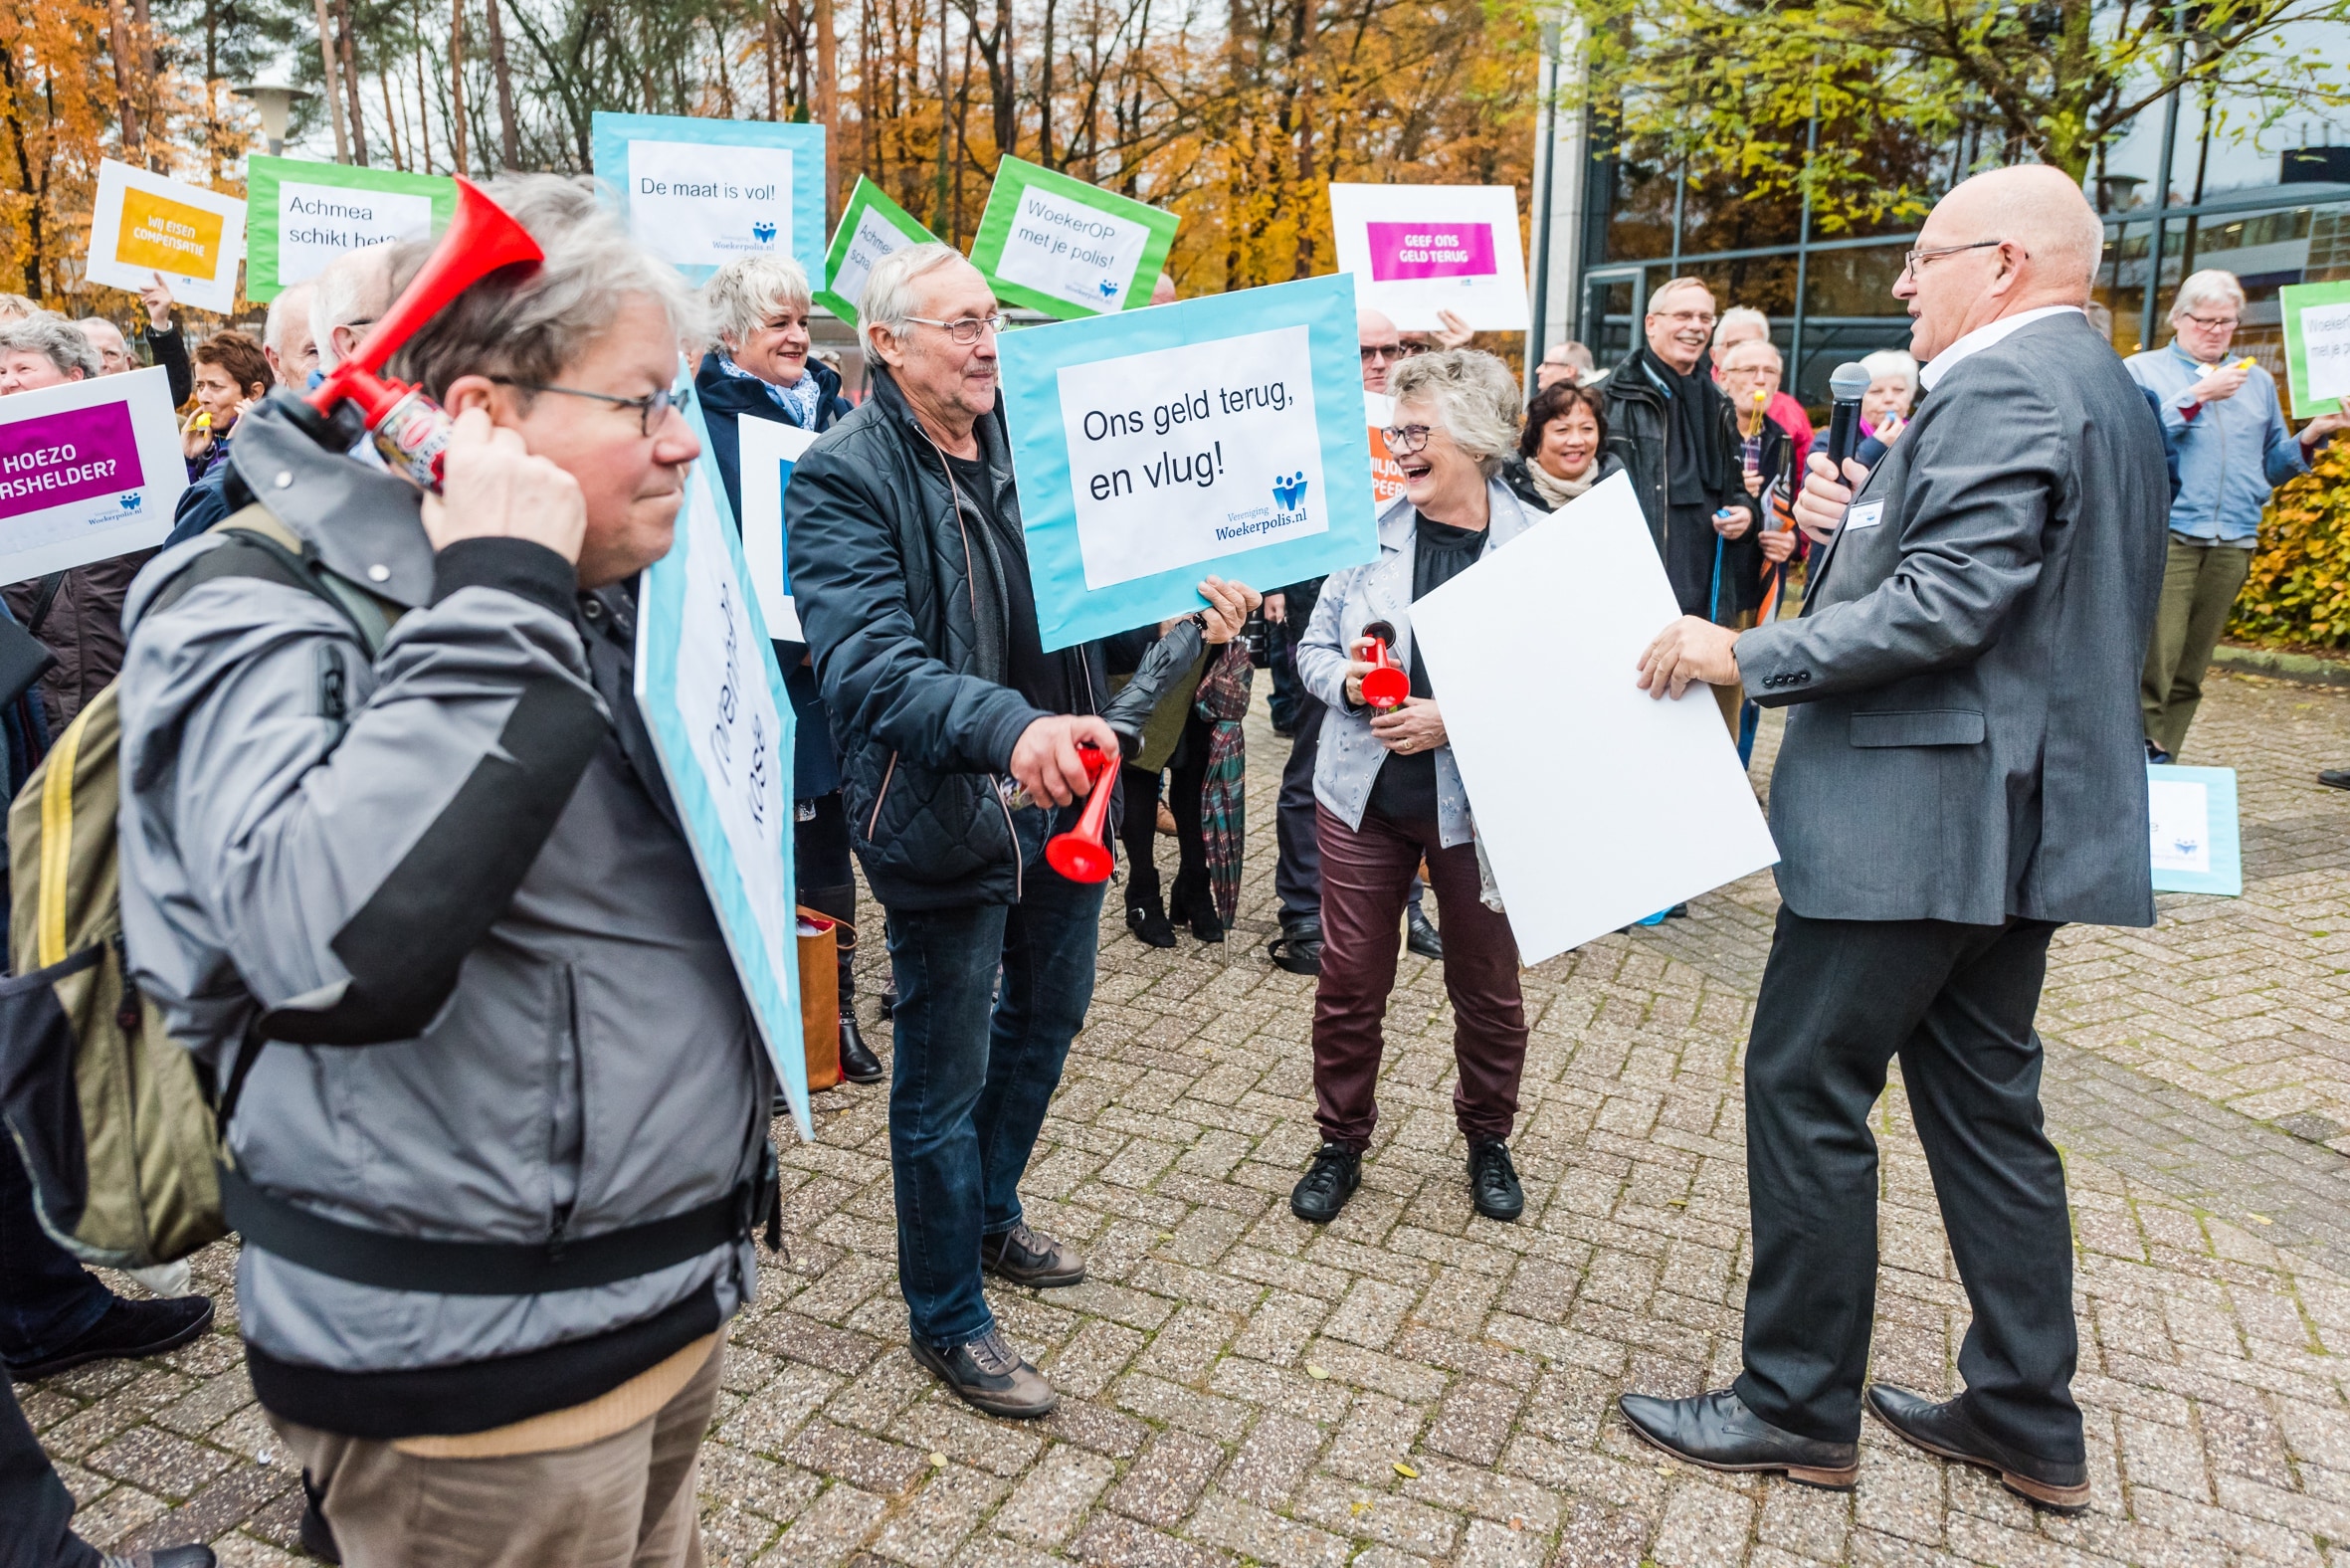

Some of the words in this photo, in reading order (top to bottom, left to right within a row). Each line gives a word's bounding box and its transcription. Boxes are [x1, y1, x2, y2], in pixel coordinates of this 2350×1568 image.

[641, 177, 667, 195] De
[674, 183, 718, 198] maat
[724, 183, 738, 198] is
[744, 185, 775, 201] vol!
[290, 196, 373, 221] Achmea
[1029, 199, 1115, 241] WoekerOP
[147, 215, 164, 232] WIJ
[166, 221, 196, 239] EISEN
[290, 228, 347, 247] schikt
[133, 227, 205, 257] COMPENSATIE
[1019, 227, 1051, 248] met
[1051, 237, 1068, 255] je
[1070, 246, 1114, 271] polis!
[1405, 235, 1433, 248] GEEF
[1435, 235, 1460, 248] ONS
[1399, 250, 1429, 263] GELD
[1430, 250, 1469, 263] TERUG
[2307, 314, 2350, 333] Woeker
[1083, 410, 1144, 442] Ons
[1153, 389, 1210, 436] geld
[1219, 381, 1293, 415] terug,
[3, 444, 77, 474] HOEZO
[1089, 469, 1132, 501] en
[1143, 441, 1225, 489] vlug!
[89, 507, 143, 526] Woekerpolis.nl
[1216, 508, 1307, 541] Woekerpolis.nl
[1228, 505, 1270, 522] Vereniging
